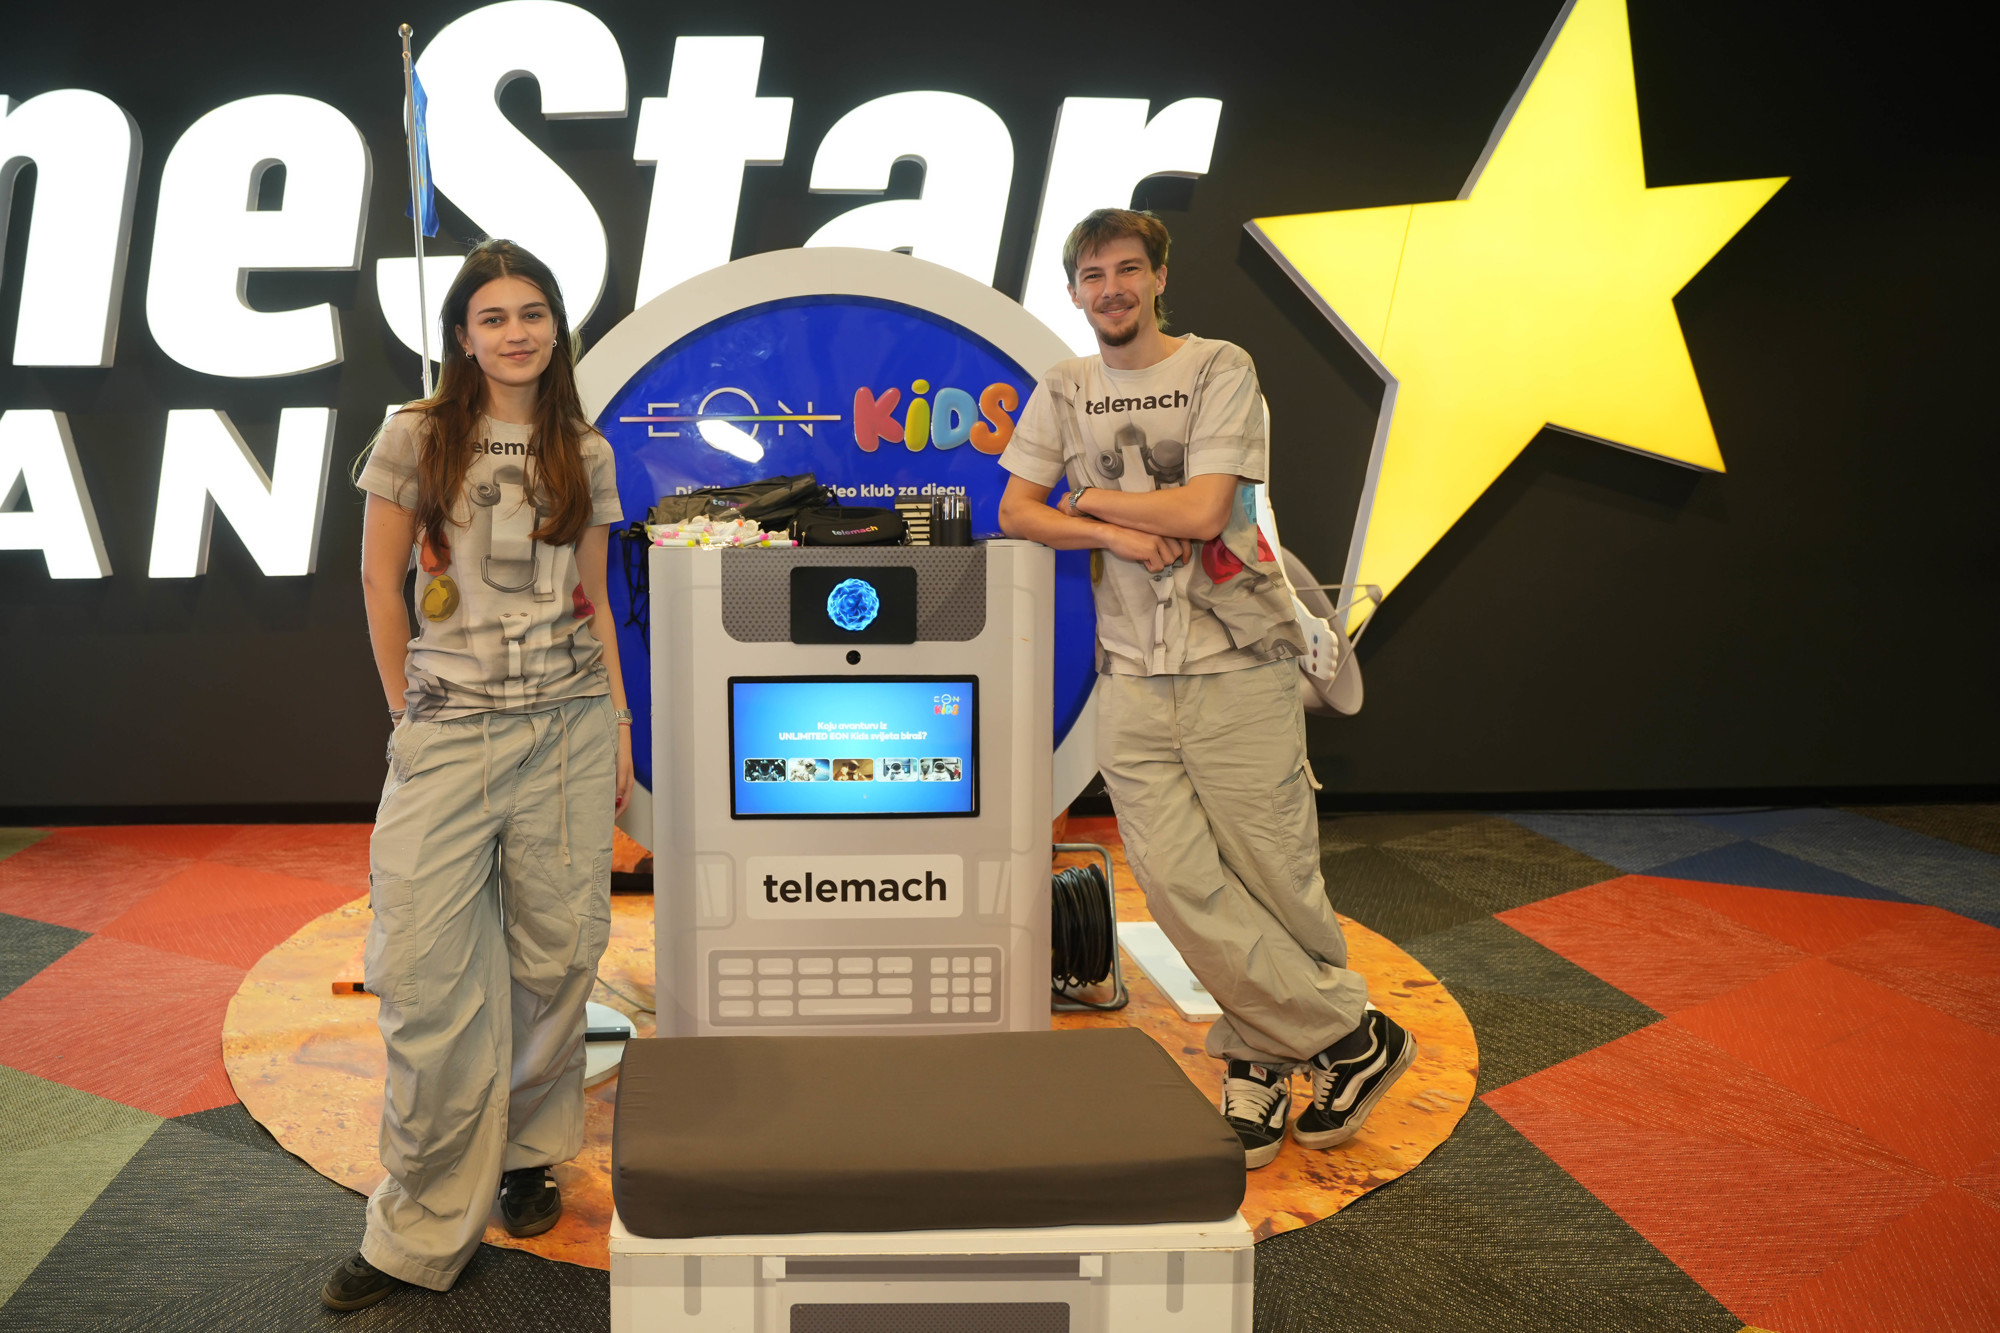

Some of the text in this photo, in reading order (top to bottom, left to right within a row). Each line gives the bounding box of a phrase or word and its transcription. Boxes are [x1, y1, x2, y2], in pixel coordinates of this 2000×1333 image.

[1086, 390, 1189, 415] telemach
[646, 386, 813, 444] EON
[472, 438, 536, 456] elema
[0, 403, 405, 579] AN
[822, 484, 857, 498] deo
[861, 484, 894, 498] klub
[898, 486, 917, 496] za
[712, 498, 750, 509] telem
[831, 525, 878, 537] telemach
[933, 693, 960, 705] EON
[817, 721, 888, 731] Koju avanturu iz
[778, 732, 828, 741] UNLIMITED
[829, 732, 849, 741] EON
[850, 731, 869, 741] Kids
[870, 731, 899, 742] svijeta
[763, 871, 947, 904] telemach
